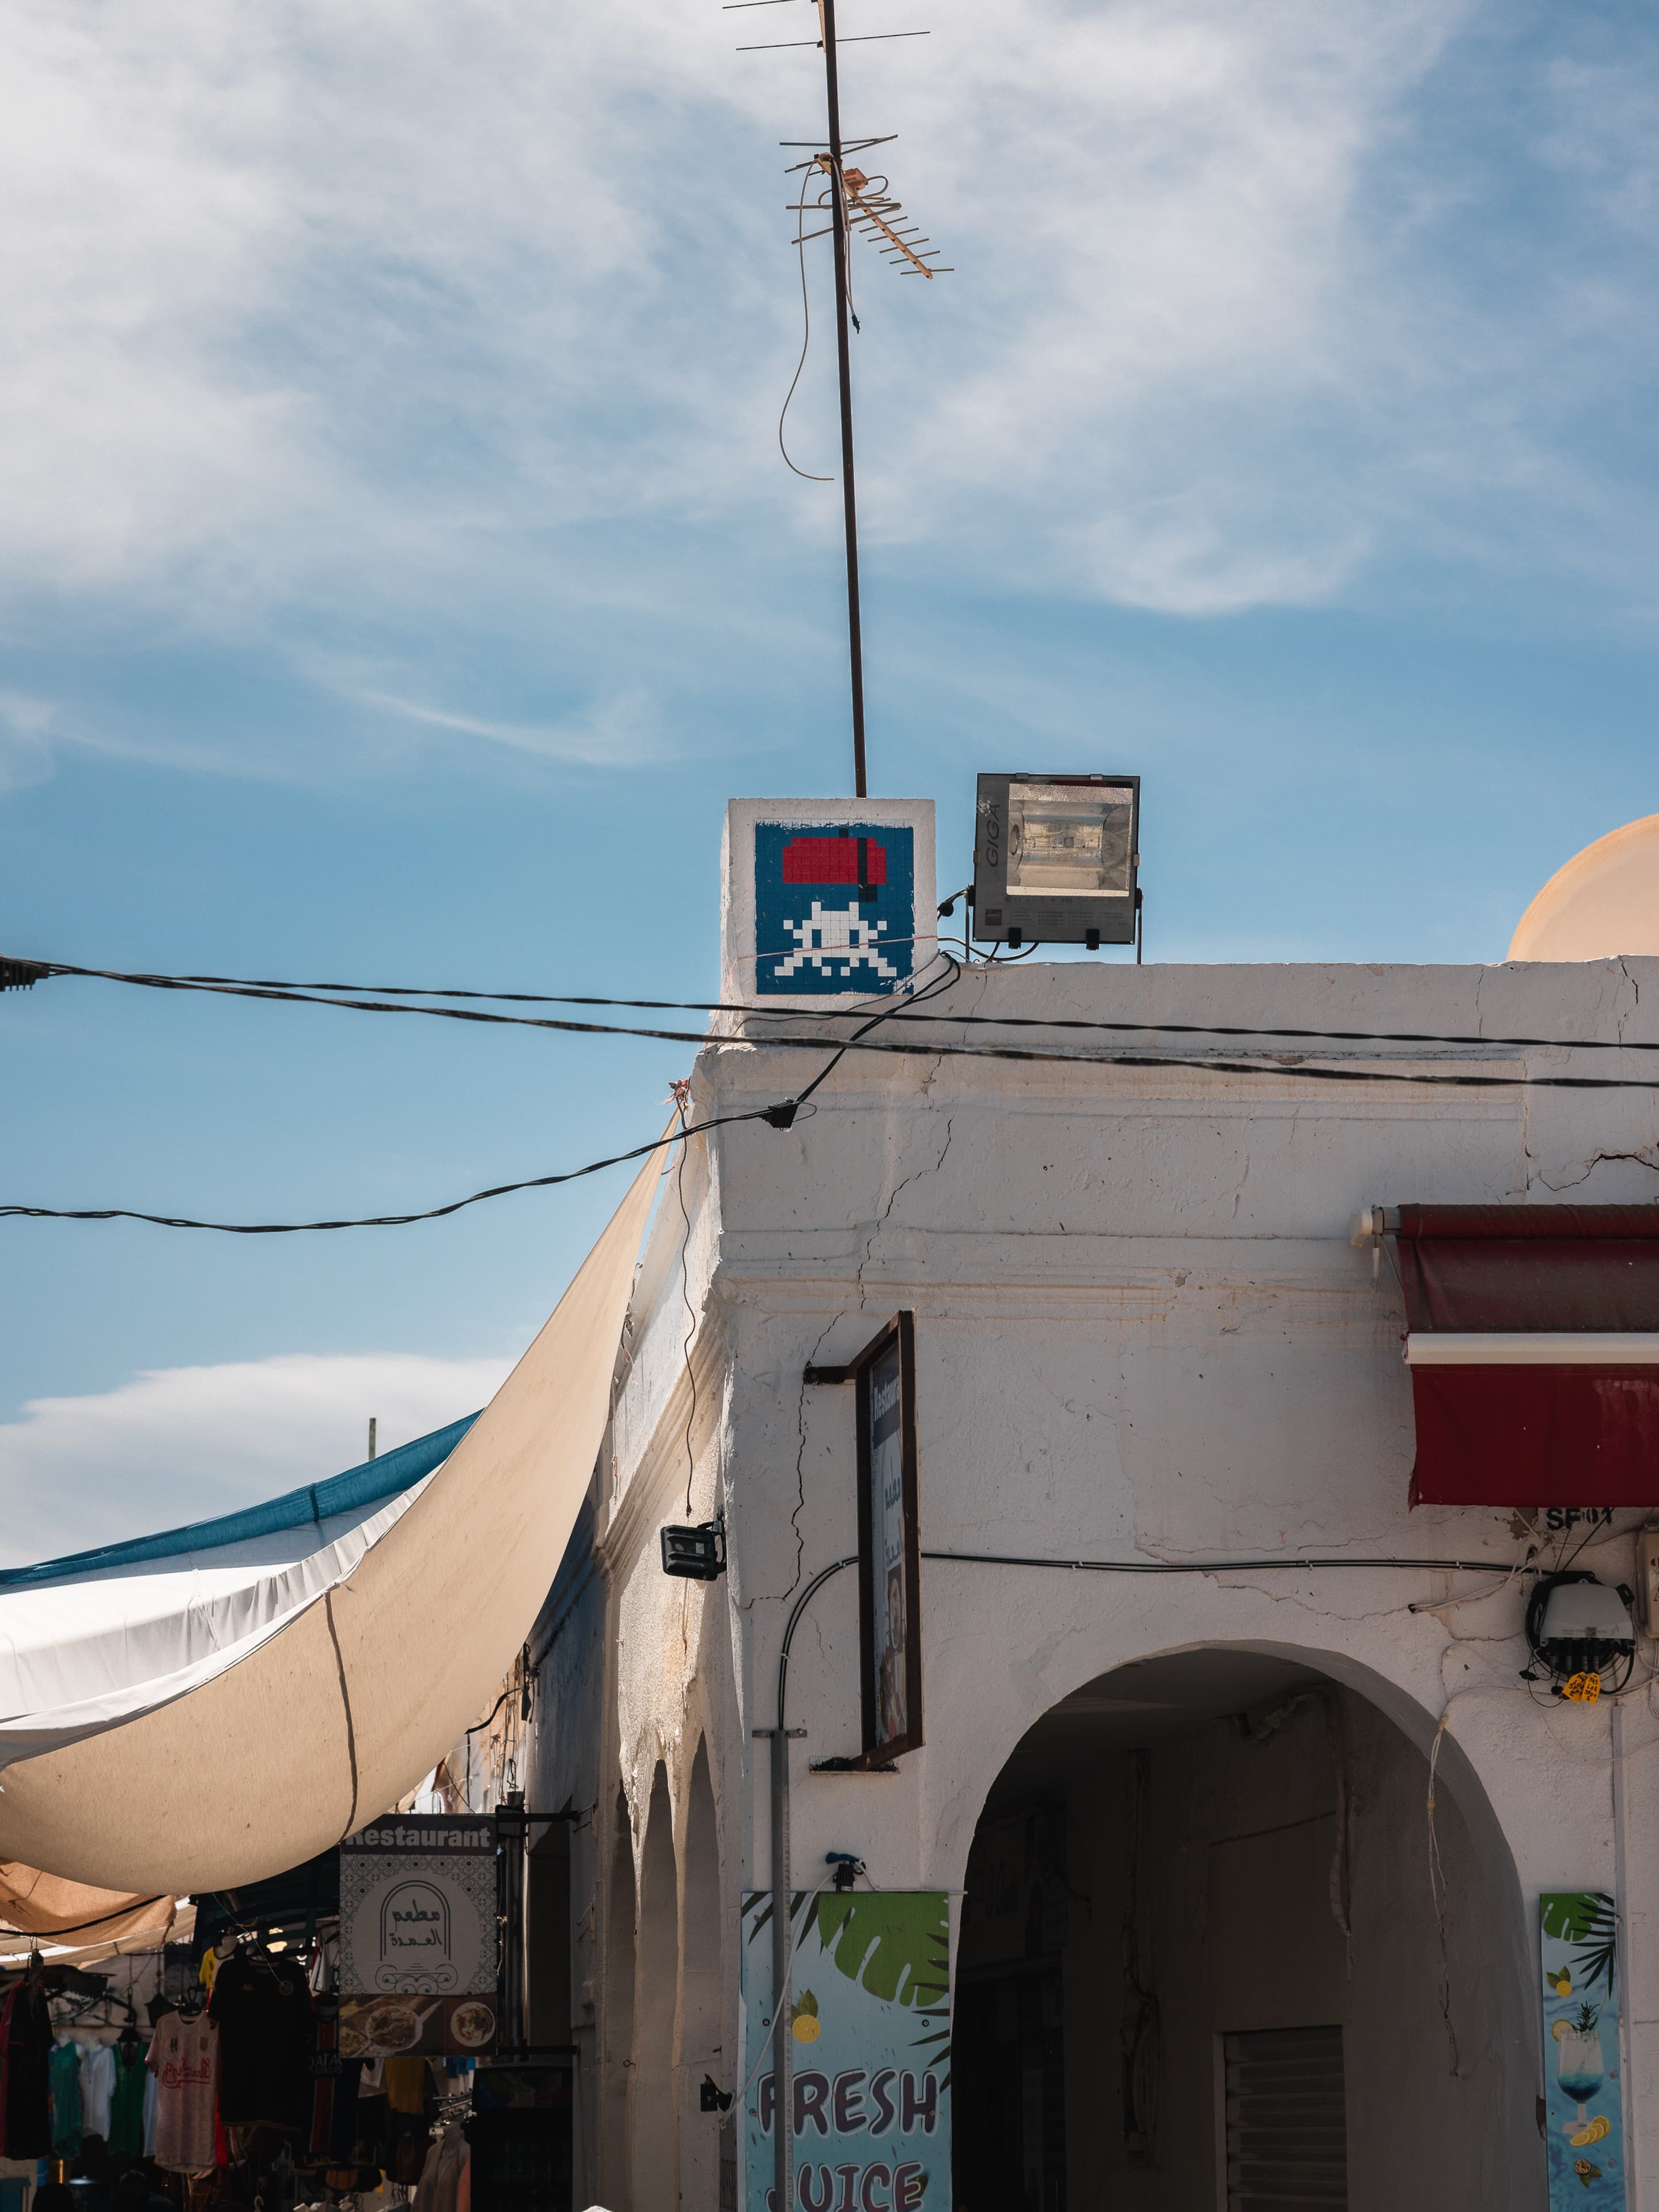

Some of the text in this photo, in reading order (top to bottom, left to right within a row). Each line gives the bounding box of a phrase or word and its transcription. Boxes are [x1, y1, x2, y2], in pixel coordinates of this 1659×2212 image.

[986, 804, 1001, 867] GIGA
[874, 1374, 900, 1422] Restaura
[389, 1928, 442, 1946] العمدة
[392, 1899, 440, 1933] مطعم
[766, 2161, 924, 2212] UICE
